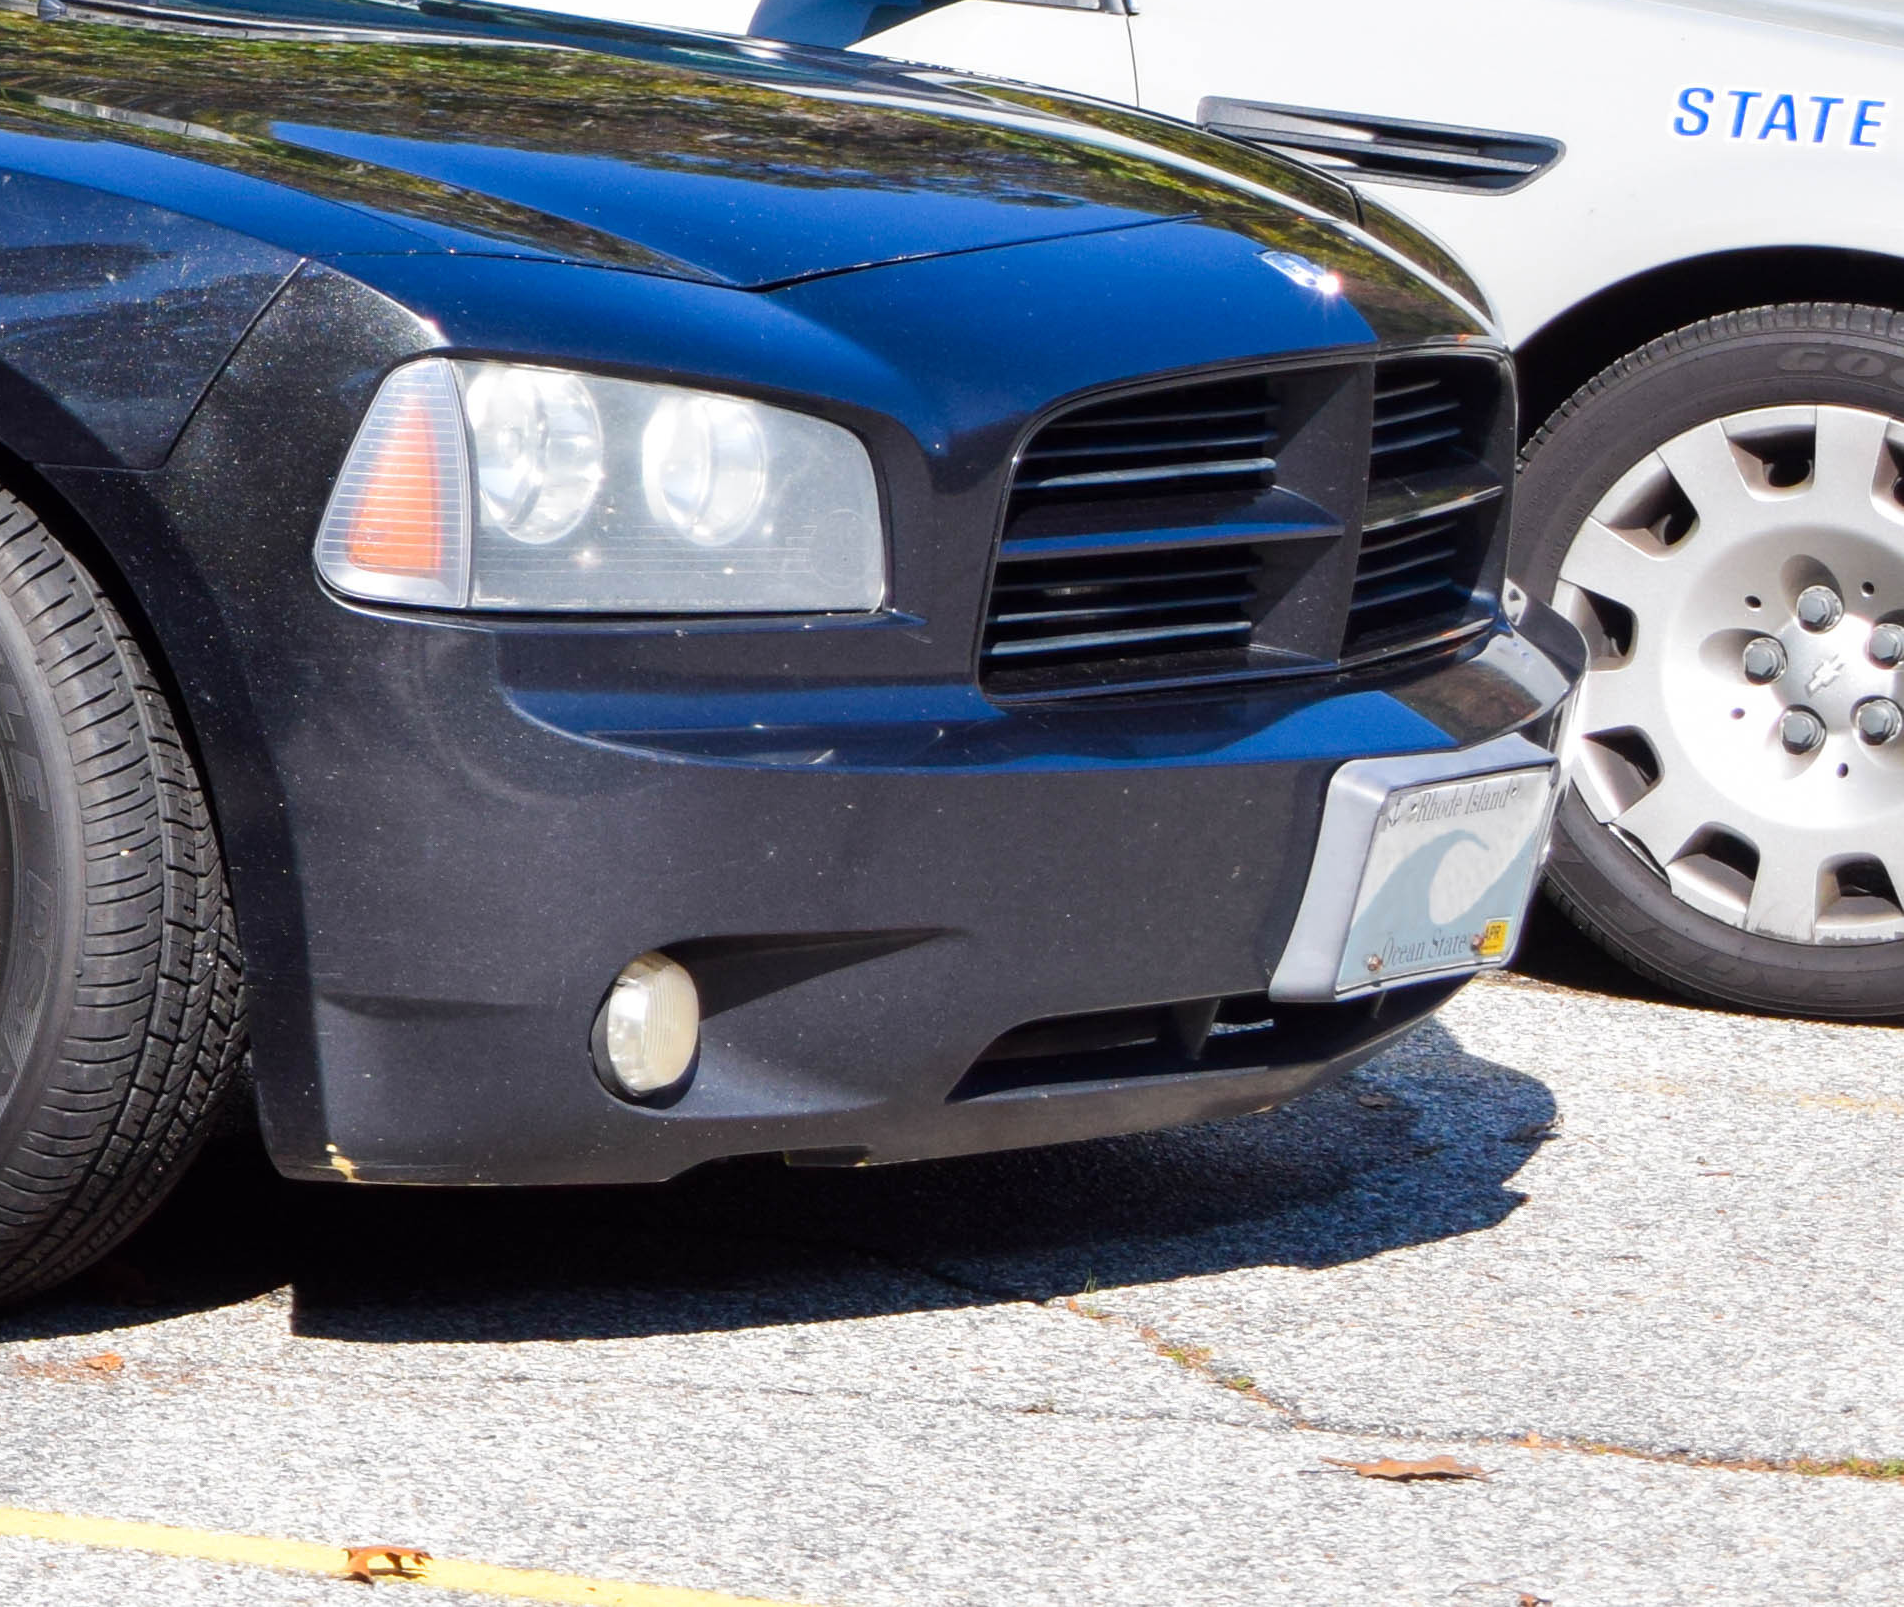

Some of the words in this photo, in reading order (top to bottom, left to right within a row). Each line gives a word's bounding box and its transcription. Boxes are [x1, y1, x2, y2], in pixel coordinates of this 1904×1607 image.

[1673, 87, 1885, 147] STATE
[1416, 787, 1463, 823] Rhode
[1464, 776, 1513, 815] Island
[1382, 932, 1425, 967] Ocean
[1428, 927, 1467, 958] State
